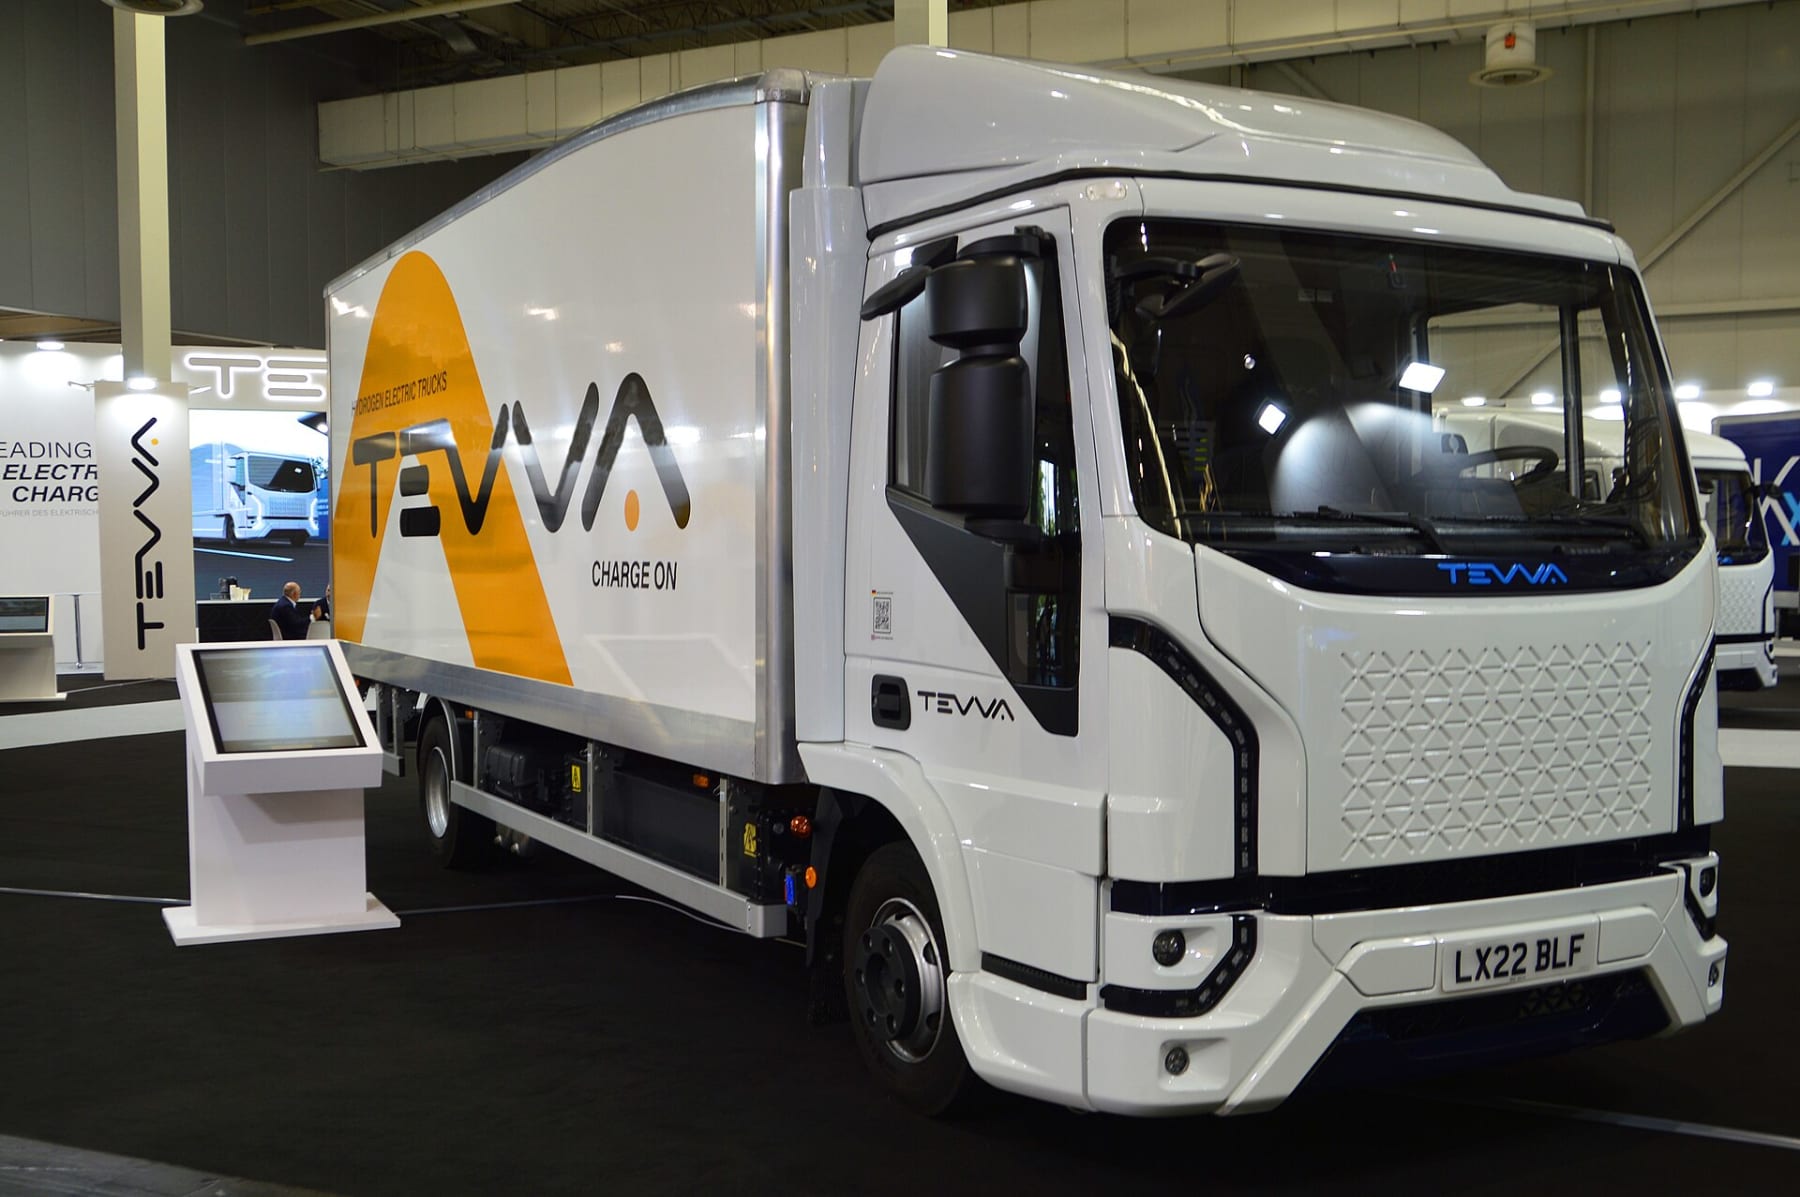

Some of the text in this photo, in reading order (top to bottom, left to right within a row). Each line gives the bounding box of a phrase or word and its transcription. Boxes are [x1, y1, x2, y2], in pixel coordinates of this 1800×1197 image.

[384, 381, 416, 407] ELECTRIC
[418, 371, 447, 398] TRUCKS
[353, 372, 690, 538] TEVVA
[592, 560, 677, 590] CHARGE ON
[1437, 562, 1568, 585] TEVVA
[917, 690, 1015, 722] TEVVA
[1455, 933, 1585, 984] LX22 BLF
